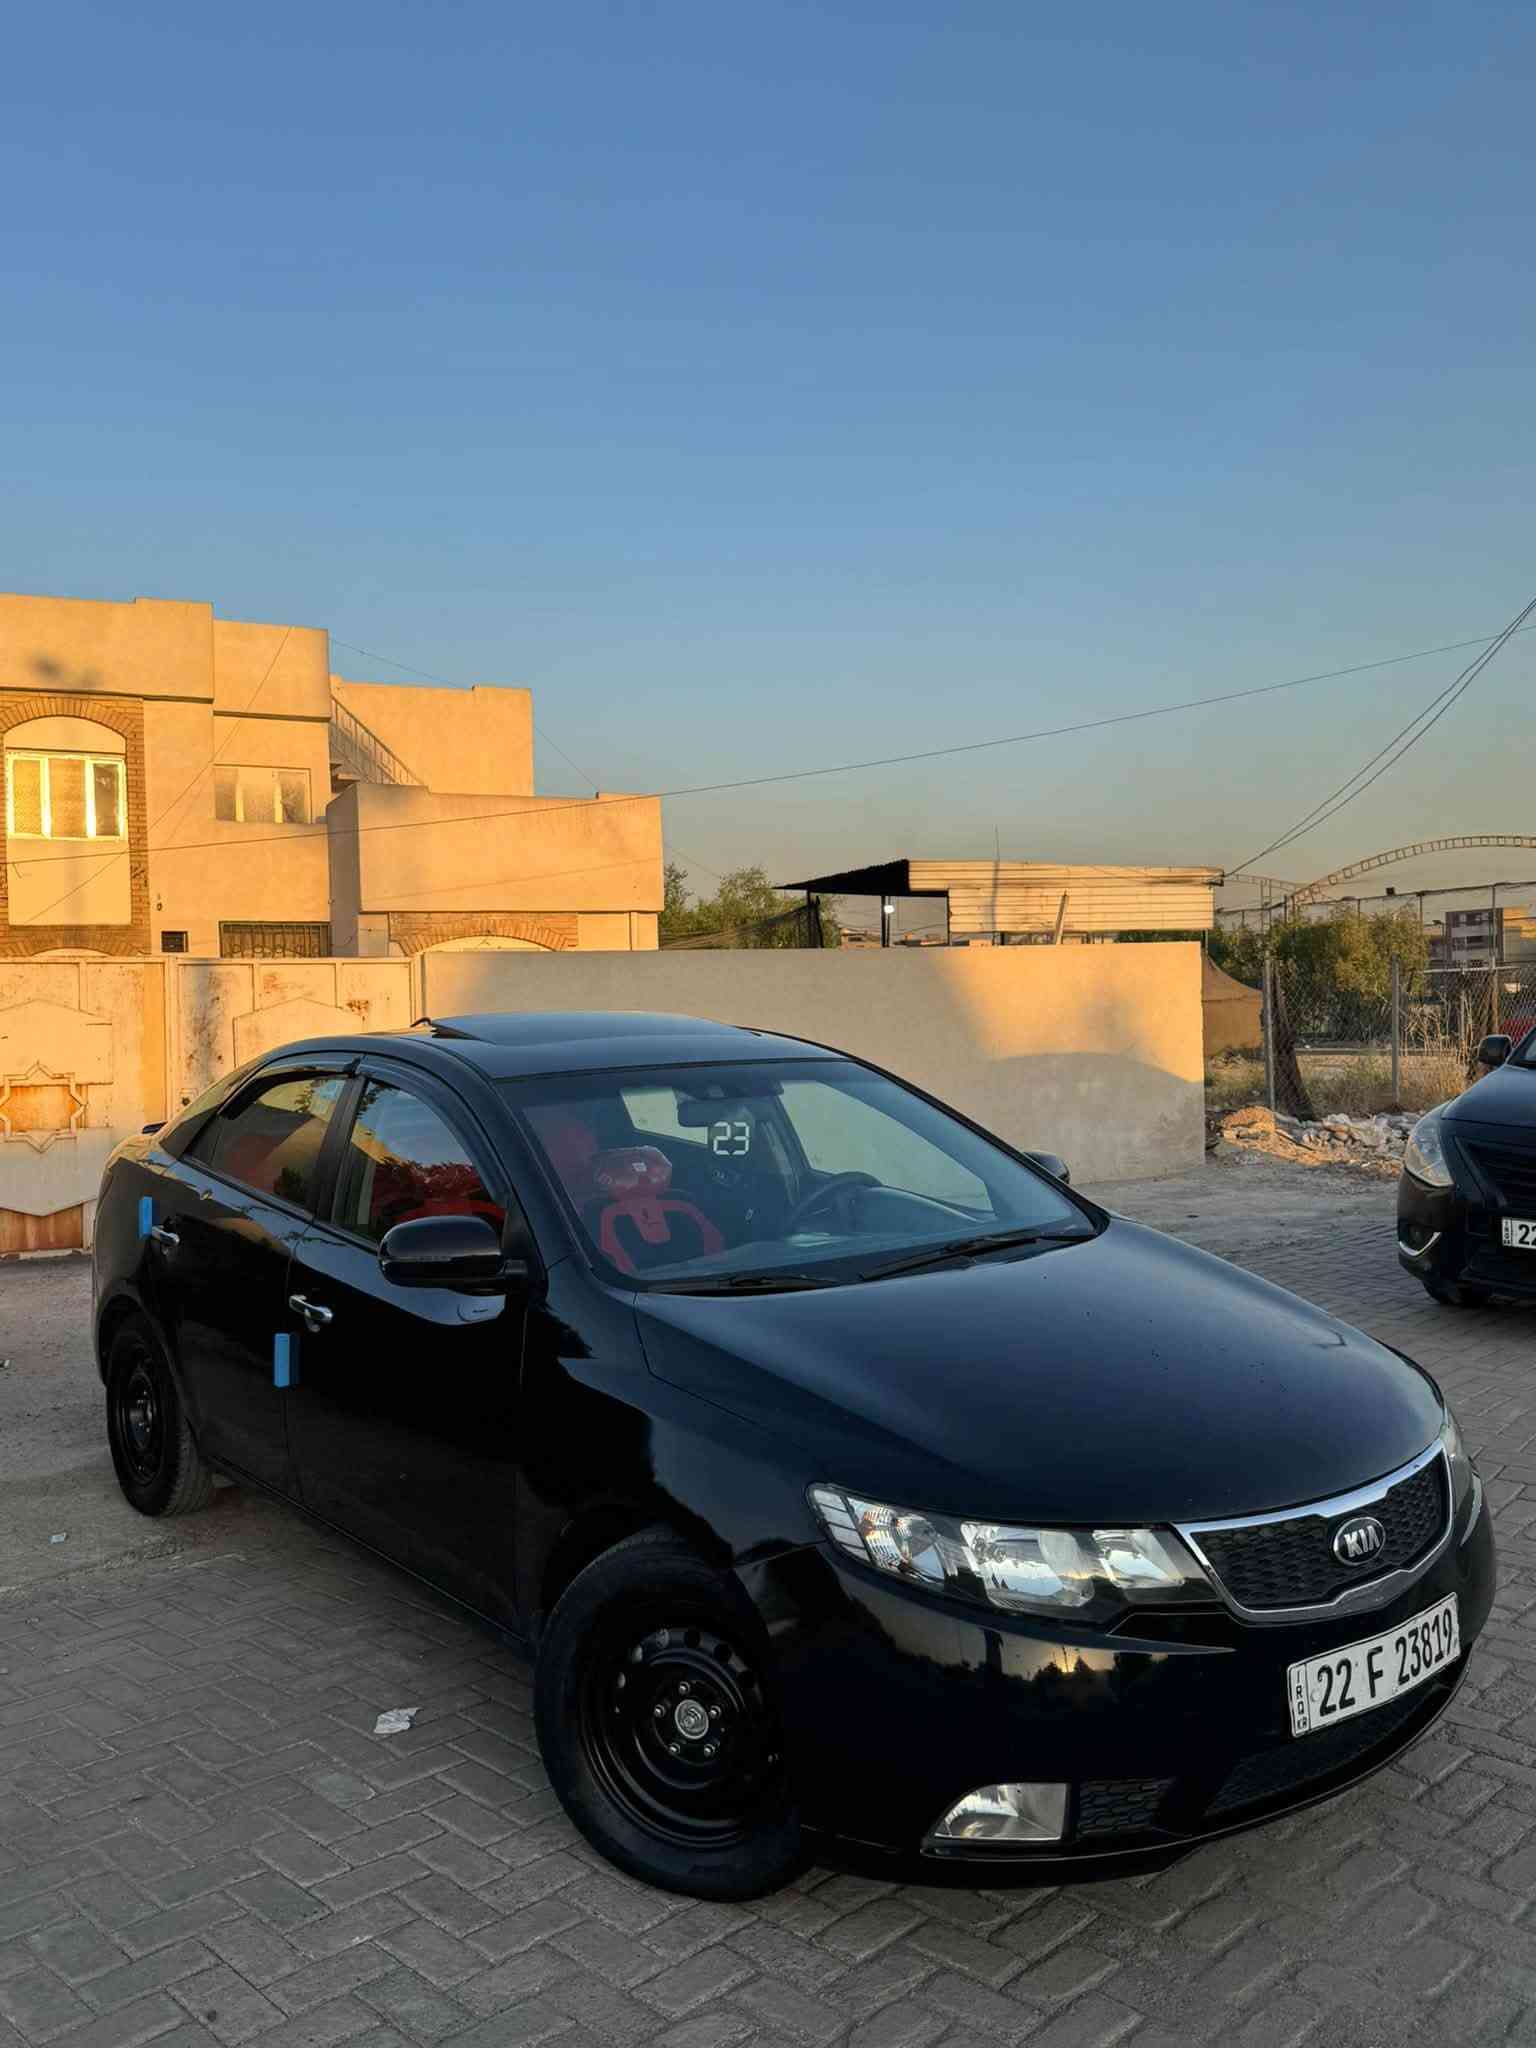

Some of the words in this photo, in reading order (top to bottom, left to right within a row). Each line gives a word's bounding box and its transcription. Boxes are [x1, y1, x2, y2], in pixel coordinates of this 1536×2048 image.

[713, 1121, 750, 1155] 23
[1344, 1525, 1380, 1558] KIA
[1317, 1658, 1356, 1717] 22
[1366, 1645, 1384, 1698] F
[1395, 1608, 1453, 1686] 23819
